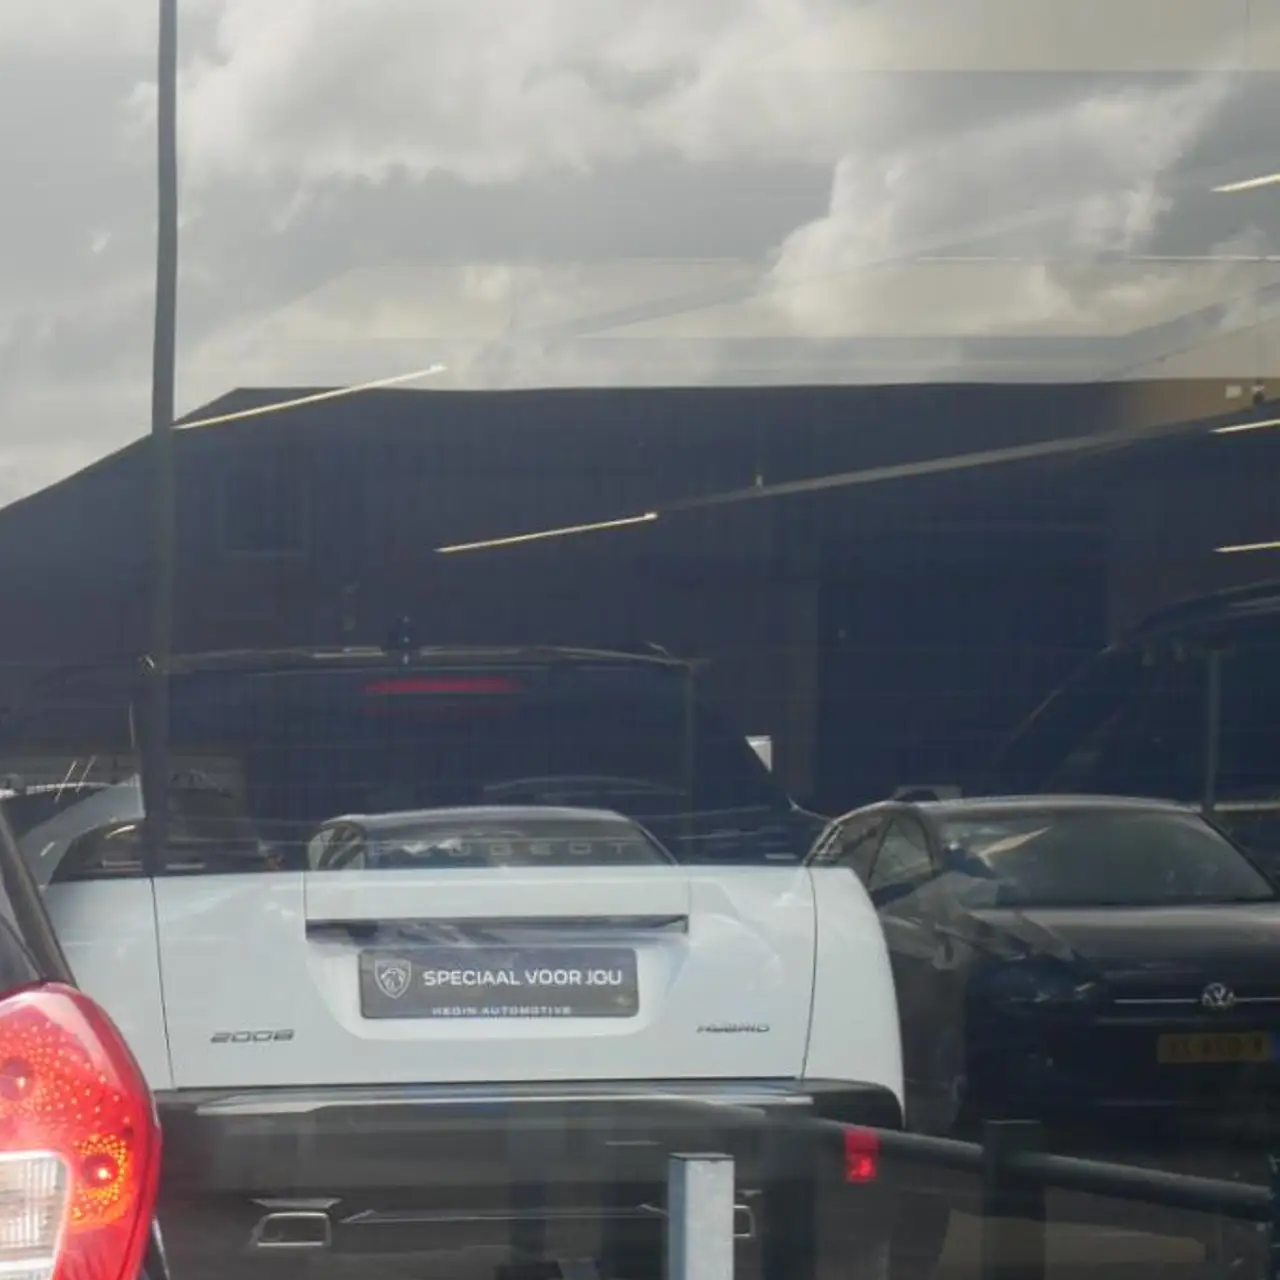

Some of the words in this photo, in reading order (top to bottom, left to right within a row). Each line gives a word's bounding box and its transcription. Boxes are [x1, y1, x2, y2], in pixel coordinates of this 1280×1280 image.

[423, 969, 521, 986] SPECIAAL
[525, 969, 582, 986] VOOR
[586, 969, 623, 986] JOU
[481, 1006, 571, 1016] AUTOMOTIVE
[210, 1029, 295, 1044] 2008
